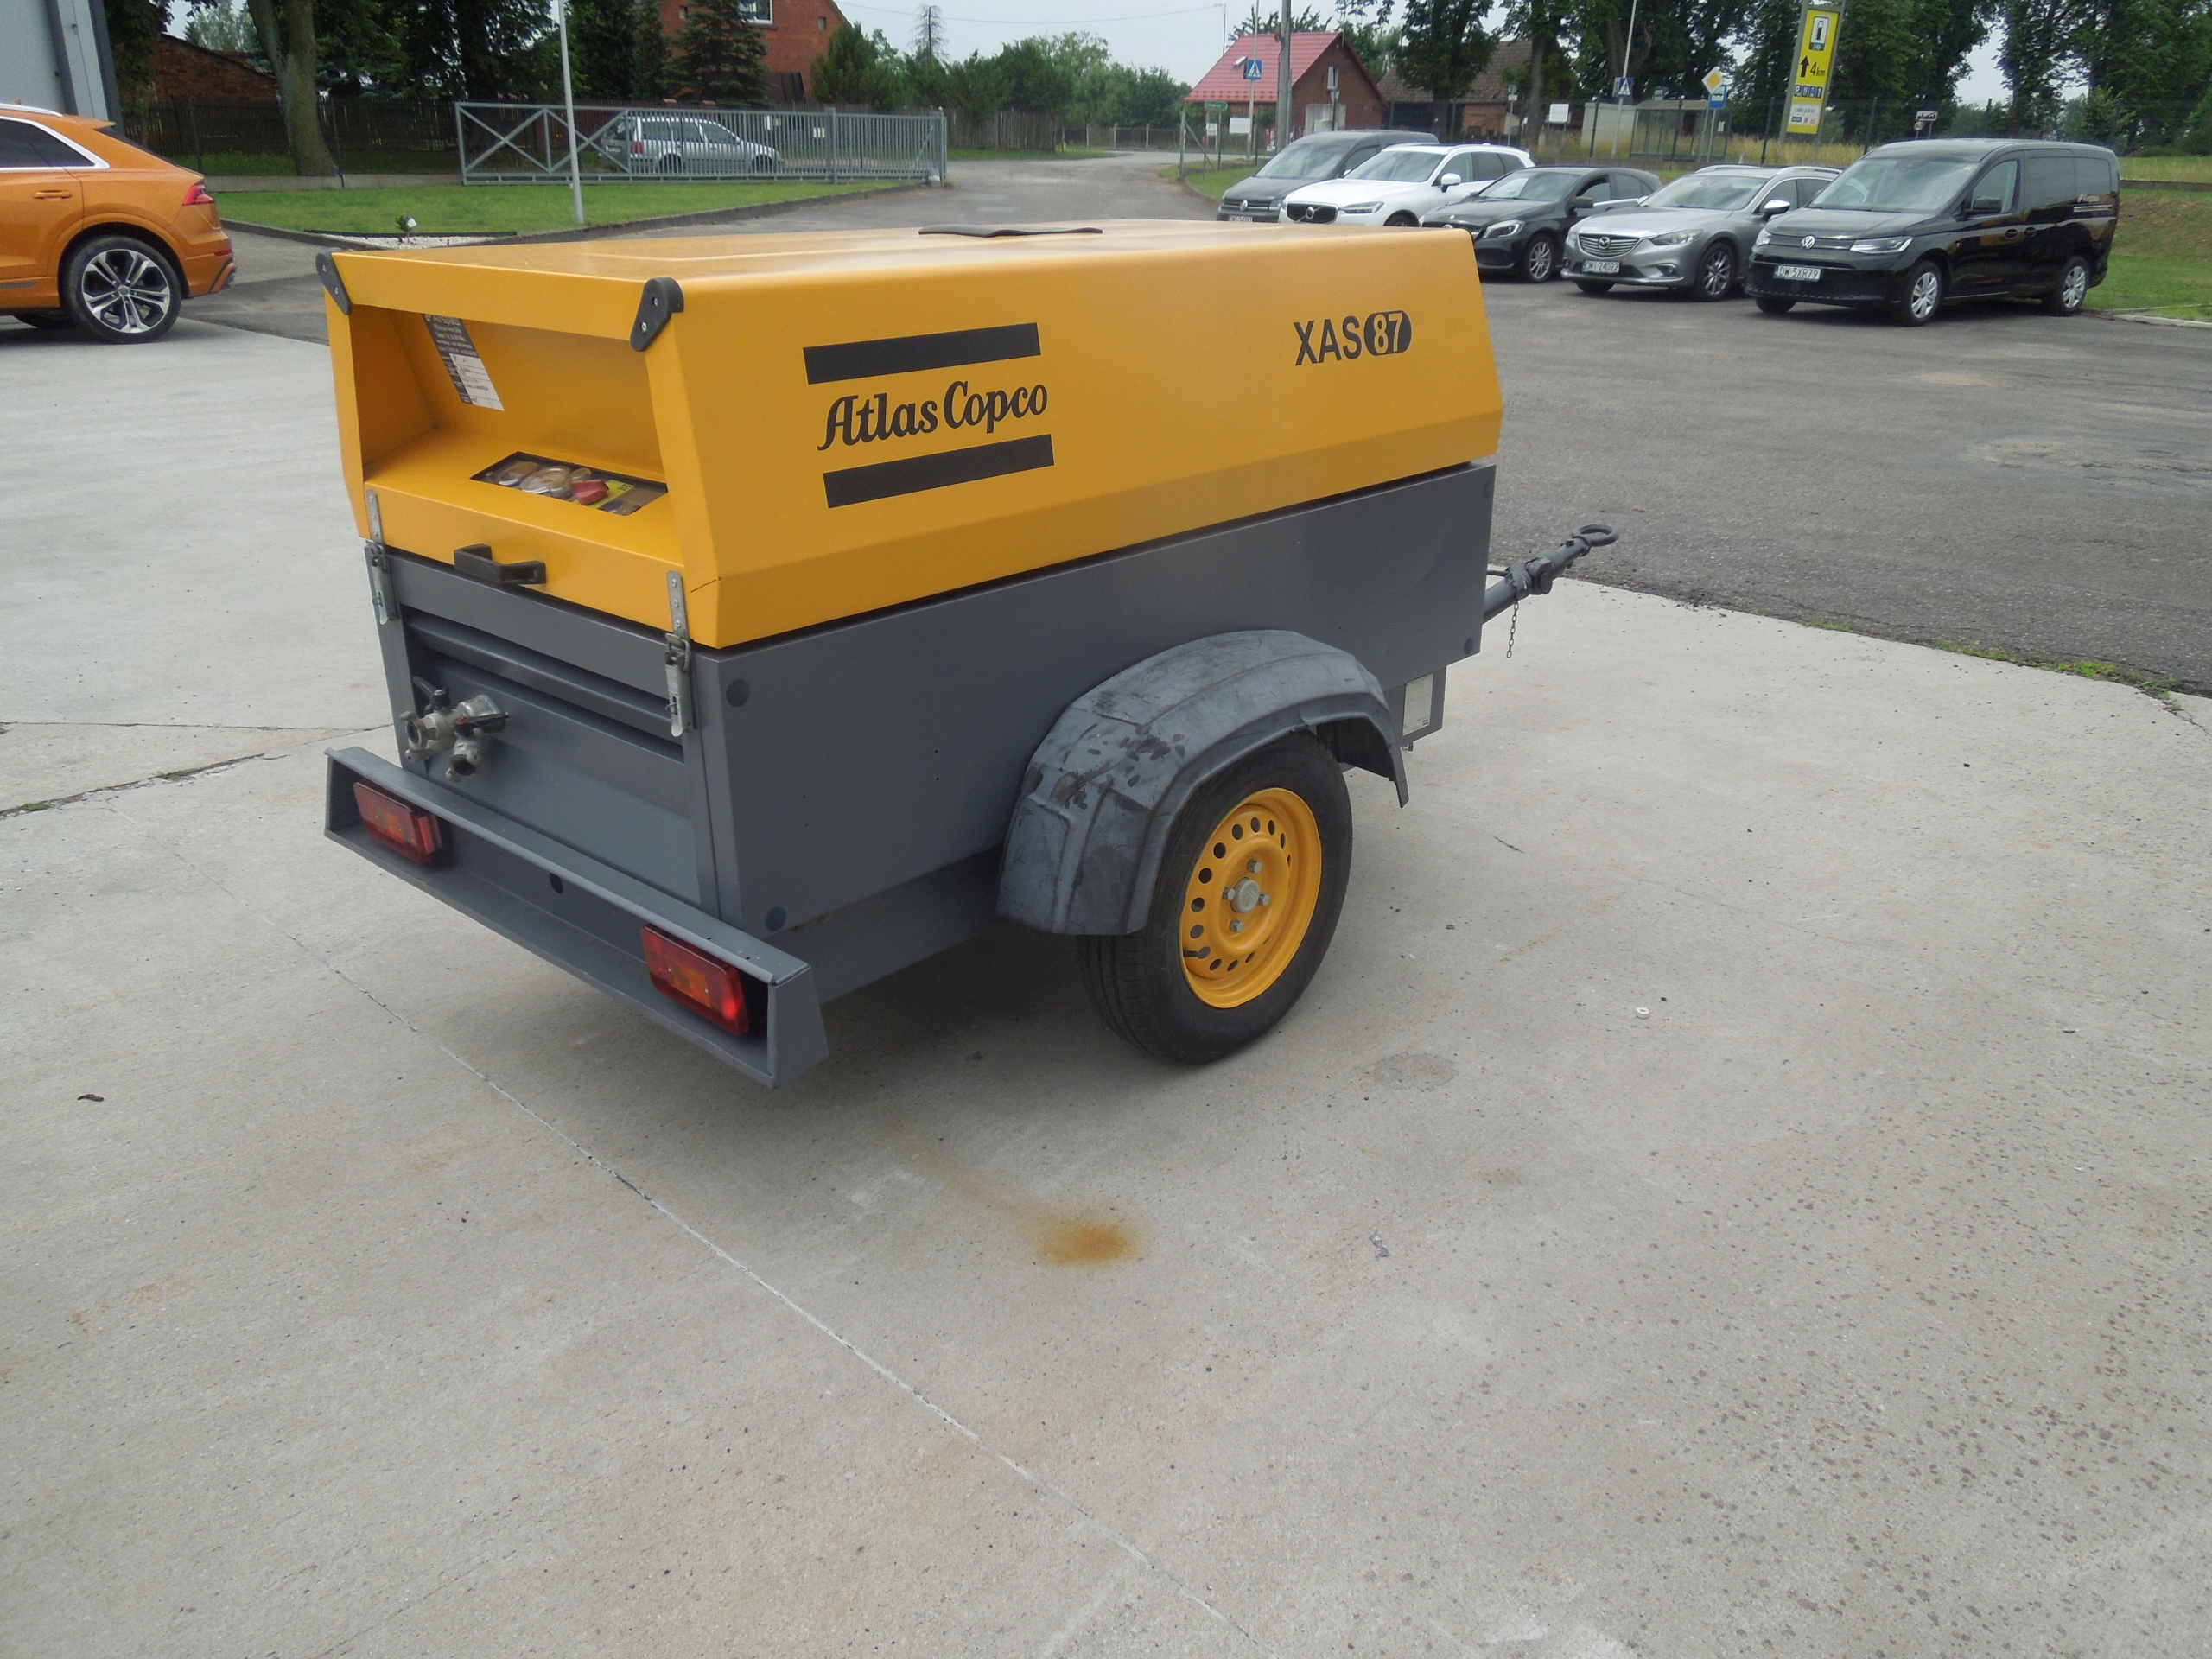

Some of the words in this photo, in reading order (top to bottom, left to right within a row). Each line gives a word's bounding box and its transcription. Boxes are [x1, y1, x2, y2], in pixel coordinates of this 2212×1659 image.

[1810, 62, 1817, 76] 4
[1816, 67, 1826, 77] km
[1780, 266, 1789, 276] DW
[1792, 268, 1819, 278] 5XR79
[1293, 315, 1362, 366] XAS
[1374, 313, 1403, 354] 87
[817, 392, 938, 451] Atlas
[943, 380, 1048, 434] Copco
